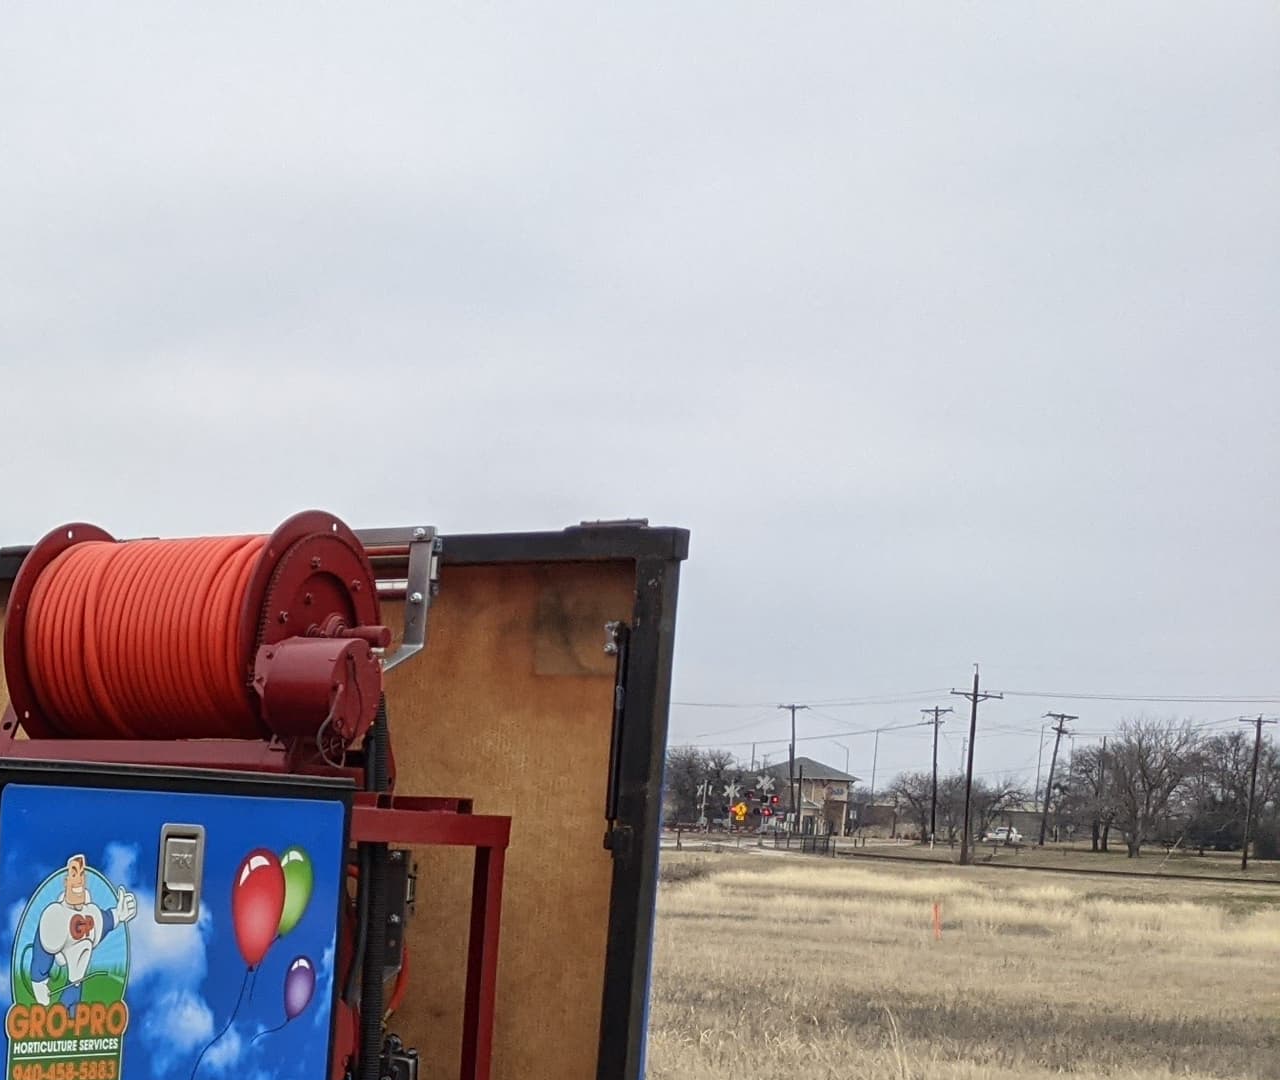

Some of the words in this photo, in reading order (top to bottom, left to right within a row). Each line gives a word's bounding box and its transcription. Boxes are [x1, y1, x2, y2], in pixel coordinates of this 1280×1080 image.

[7, 1001, 127, 1039] GRO-PRO
[13, 1039, 78, 1055] HORTICULTURE
[78, 1038, 119, 1051] SERVICES
